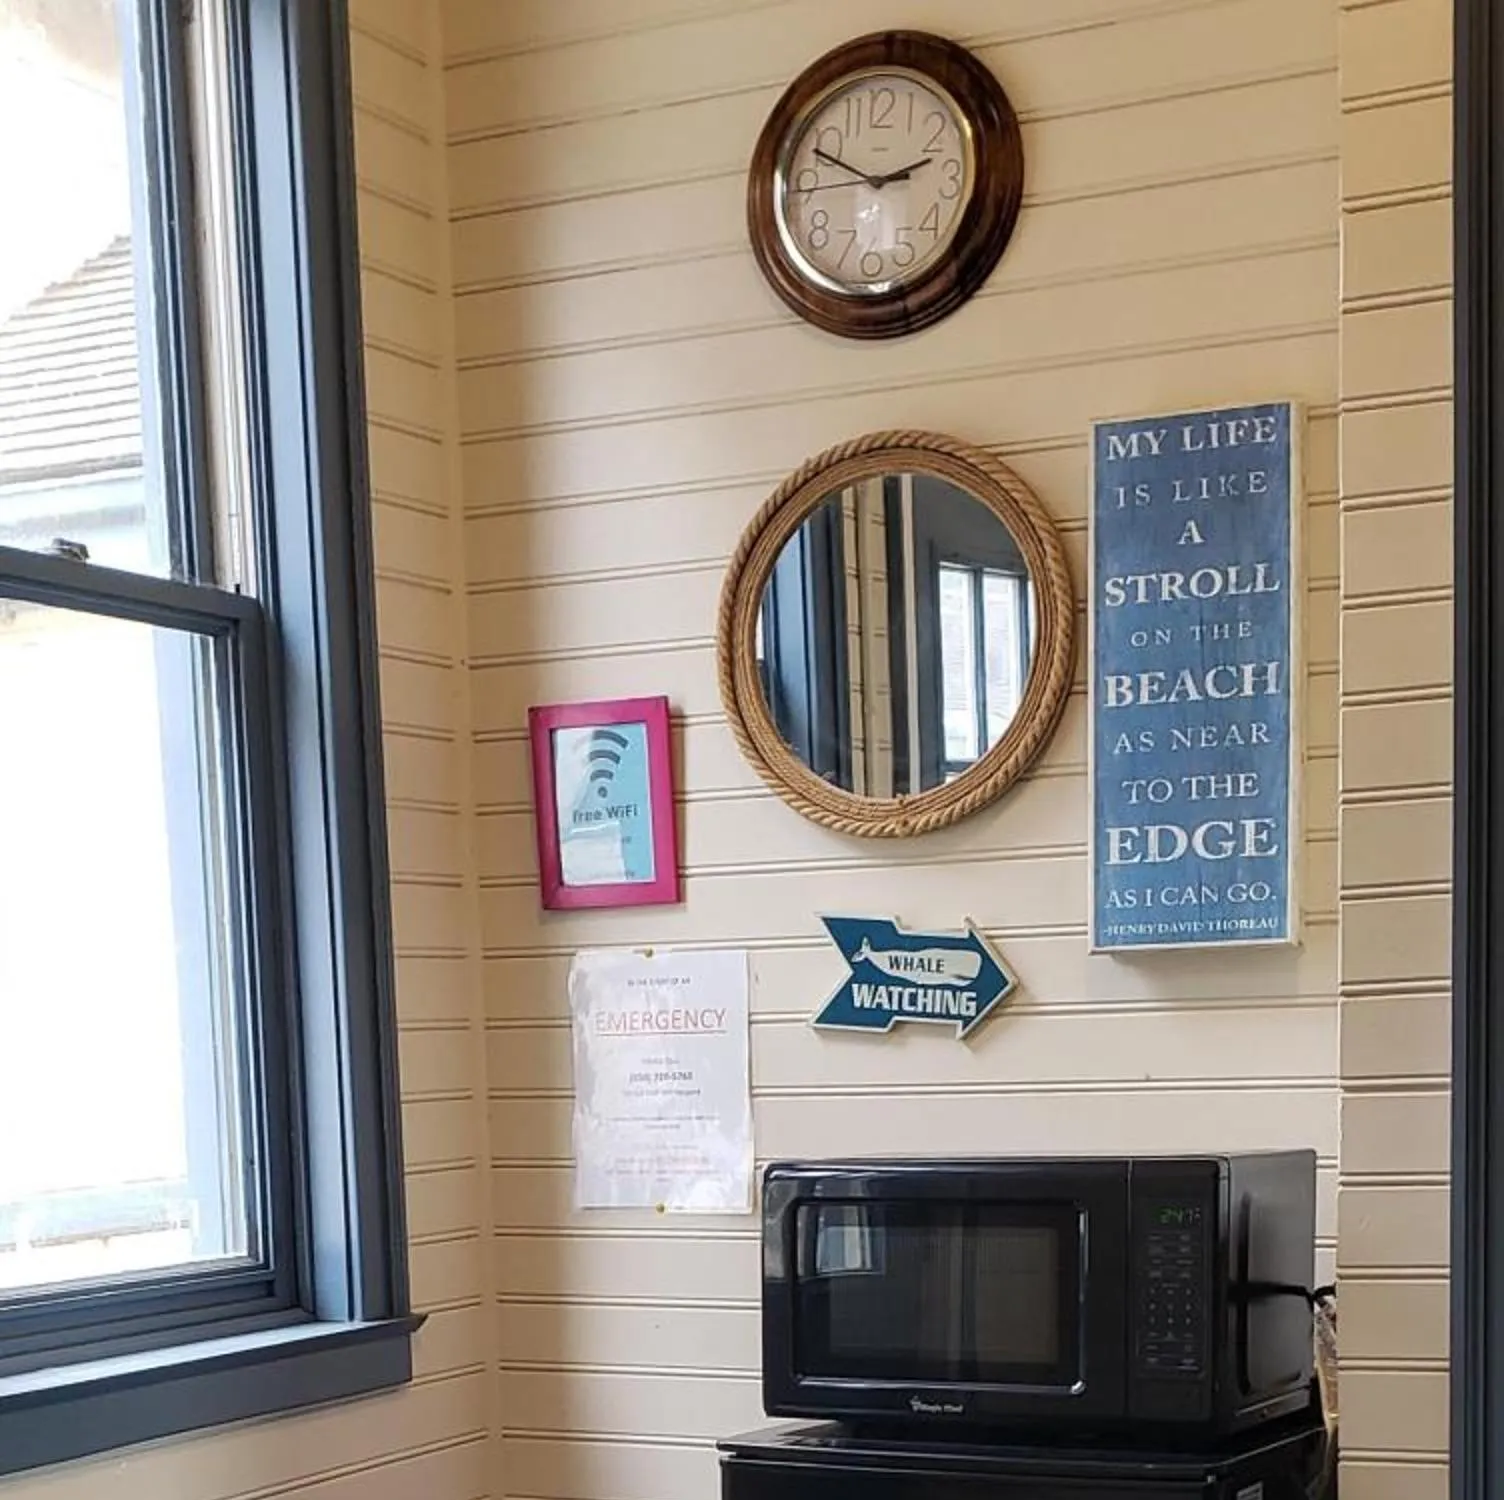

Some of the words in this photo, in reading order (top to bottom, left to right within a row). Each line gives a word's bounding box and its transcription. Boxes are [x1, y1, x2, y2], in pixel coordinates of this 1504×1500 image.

[844, 97, 861, 138] 11
[868, 88, 896, 129] 12
[906, 92, 914, 134] 1
[815, 126, 843, 168] 10
[922, 111, 945, 154] 2
[796, 168, 818, 204] 9
[939, 159, 961, 200] 3
[808, 210, 828, 249] 8
[918, 202, 940, 240] 4
[837, 230, 857, 269] 7
[861, 238, 883, 278] 6
[892, 227, 915, 267] 5
[1106, 429, 1167, 461] MY
[1182, 416, 1277, 451] LIFE
[1114, 483, 1151, 509] IS
[1172, 471, 1268, 503] LIKE
[1177, 519, 1205, 545] A
[1104, 563, 1281, 607] STROLL
[1130, 628, 1171, 648] ON
[1190, 621, 1253, 641] THE
[1103, 661, 1281, 708] BEACH
[1113, 731, 1155, 755] AS
[1170, 723, 1271, 750] NEAR
[1122, 778, 1173, 805] TO
[1182, 773, 1260, 800] THE
[572, 809, 603, 824] free
[1104, 818, 1279, 865] EDGE
[1104, 888, 1137, 909] AS
[1145, 889, 1153, 907] I
[1161, 885, 1220, 907] CAN
[1227, 881, 1278, 903] GO.
[1156, 920, 1204, 934] DAVID
[1207, 916, 1279, 933] THOREAU
[888, 955, 945, 973] WHALE
[596, 1007, 727, 1032] EMERGENCY
[851, 983, 977, 1017] WATCHING
